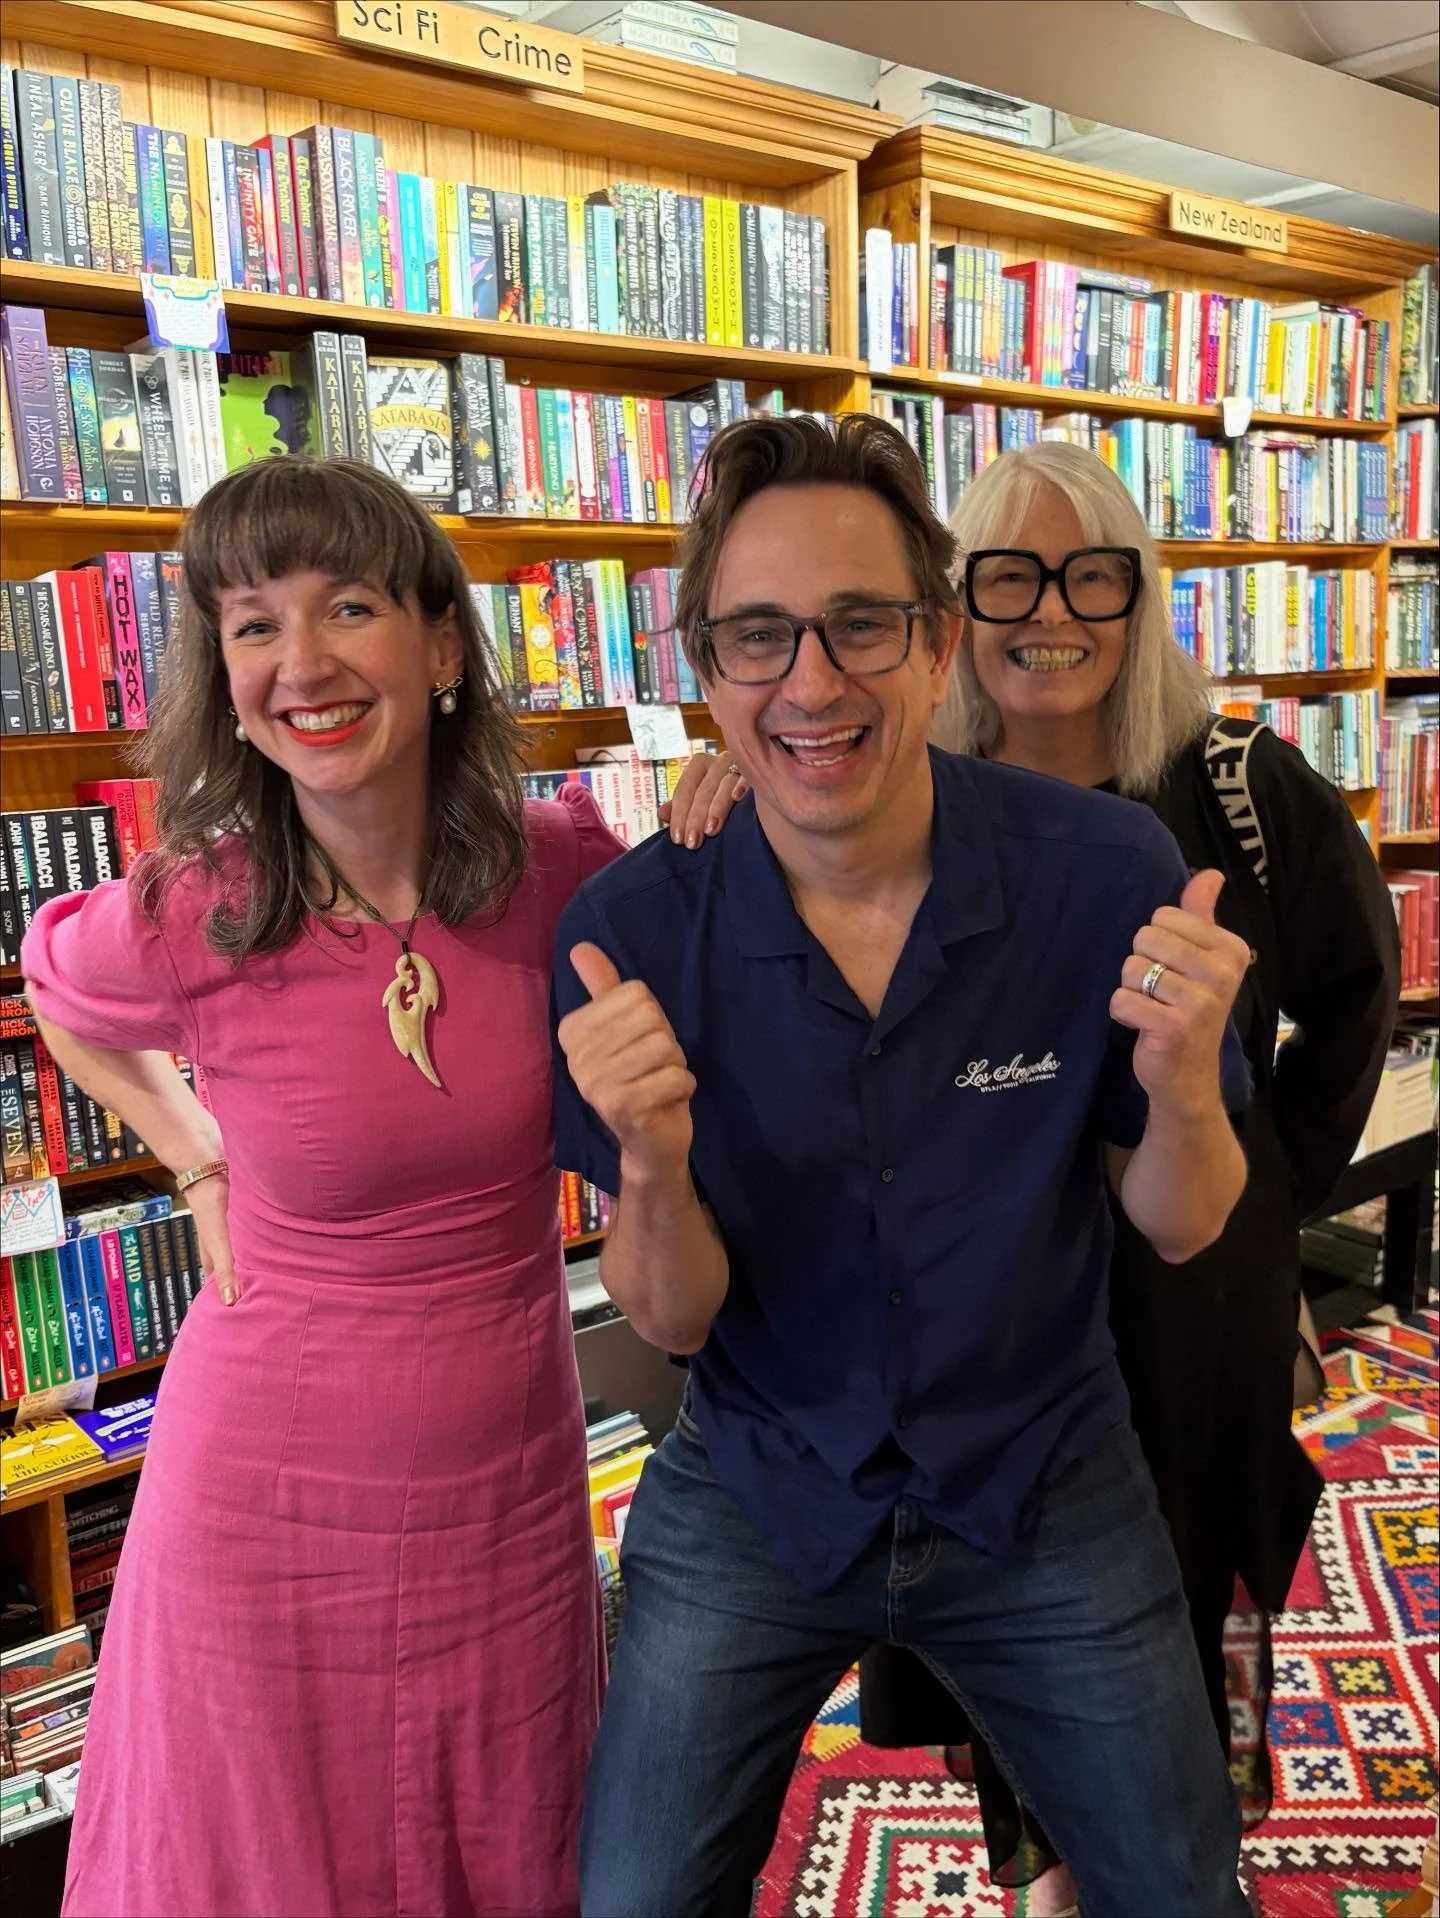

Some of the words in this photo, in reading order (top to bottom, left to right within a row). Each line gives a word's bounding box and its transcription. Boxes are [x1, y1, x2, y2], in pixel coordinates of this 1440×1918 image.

[354, 0, 402, 36] Sci
[416, 9, 440, 45] Fi
[478, 26, 571, 76] Crime
[28, 84, 43, 118] NEAL
[59, 87, 76, 136] OLIVIE
[79, 84, 95, 155] UNKNOWABLE
[101, 88, 116, 158] UNKNOWABLE
[31, 123, 47, 166] ASHER
[63, 140, 80, 184] BLAKE
[92, 127, 105, 167] SOCIETY
[113, 129, 125, 169] SOCIETY
[147, 132, 160, 159] THE
[337, 137, 353, 190] BLACK
[85, 156, 97, 198] OBJECTS
[106, 159, 118, 199] OBJECTS
[318, 135, 333, 194] SEASON
[357, 150, 371, 210] MORRIGAN
[375, 157, 386, 194] QUEEN
[39, 185, 49, 206] DARK
[242, 167, 256, 224] INFINITY
[40, 210, 52, 247] DIAMOND
[66, 204, 77, 247] TALENTED
[89, 201, 102, 248] BROWN
[98, 200, 110, 248] GARETH
[109, 203, 122, 249] BROWN
[119, 203, 131, 250] GARETH
[324, 203, 338, 243] FEAR
[341, 194, 357, 237] RIVER
[510, 217, 520, 250] STEVEN
[530, 199, 542, 241] JASPER
[663, 197, 677, 242] SILVER
[1179, 201, 1216, 230] New
[1220, 210, 1283, 243] Zealand
[246, 224, 259, 257] GATE
[666, 241, 678, 278] ELITE
[532, 243, 543, 285] FFORDE
[557, 247, 568, 285] THINGS
[709, 219, 721, 328] OVERGROWTH
[727, 222, 739, 329] OVERGROWTH
[51, 363, 65, 410] OBELISK
[58, 410, 70, 437] GATE
[75, 367, 88, 411] STONE
[82, 413, 94, 440] SKY
[324, 358, 343, 457] KATABAS
[352, 361, 369, 463] KATABAS
[463, 376, 485, 434] ACADEMY
[475, 380, 492, 428] ARCANA
[26, 415, 45, 470] HODGSON
[38, 415, 57, 470] ANTONIA
[150, 392, 165, 437] WHEEL
[159, 446, 171, 484] TIME
[547, 440, 560, 491] HEARTSONG
[1, 589, 16, 651] CHRISTOPHER
[38, 602, 51, 628] STARS
[112, 575, 132, 644] HOT
[148, 590, 160, 623] WILD
[587, 602, 597, 636] HOUSE
[19, 628, 29, 657] GAIMAN
[24, 622, 36, 661] PRATCHETT
[140, 612, 151, 651] REBECCA
[575, 607, 588, 647] CHAINS
[43, 640, 56, 669] DYING
[145, 652, 155, 674] ROSS
[30, 685, 39, 705] GOOD
[120, 650, 140, 711] WAX
[31, 706, 41, 728] OMENS
[630, 749, 641, 775] TERRY
[632, 776, 643, 805] DEARY
[644, 775, 654, 805] DEARY
[656, 766, 668, 804] CHEMIS
[116, 792, 127, 822] BAUER
[123, 788, 135, 823] BELINDA
[10, 820, 22, 847] JOHN
[95, 821, 112, 882] BALDACCI
[13, 847, 30, 891] BANVILLE
[33, 820, 54, 889] BALDACCI
[62, 837, 83, 891] BALDAC
[21, 893, 30, 909] THE
[3, 910, 14, 935] SNOW
[4, 1054, 17, 1077] CHRIS
[19, 1050, 35, 1074] THE
[955, 1059, 992, 1087] Los
[993, 1051, 1061, 1081] Angeles
[1, 1088, 17, 1096] THE
[21, 1074, 37, 1092] DRY
[42, 1080, 50, 1099] LOVE
[2, 1096, 25, 1157] SEVEN
[27, 1099, 40, 1120] JANE
[67, 1101, 77, 1120] JANE
[31, 1121, 43, 1152] HARPER
[70, 1121, 80, 1151] HARPER
[90, 1118, 99, 1145] HARPER
[140, 1228, 151, 1245] IAN
[158, 1224, 168, 1241] IAN
[109, 1248, 119, 1281] POMARE
[125, 1247, 142, 1283] MAID
[143, 1246, 155, 1280] RANKIN
[160, 1241, 171, 1275] RANKIN
[149, 1280, 159, 1308] MIDNIGHT
[165, 1275, 175, 1304] MIDNIGHT
[183, 1270, 193, 1299] MIDNIGHT
[115, 1293, 125, 1320] YEARS
[153, 1309, 161, 1323] AND
[169, 1305, 177, 1318] AND
[119, 1321, 129, 1347] LATER
[155, 1323, 163, 1340] BLUE
